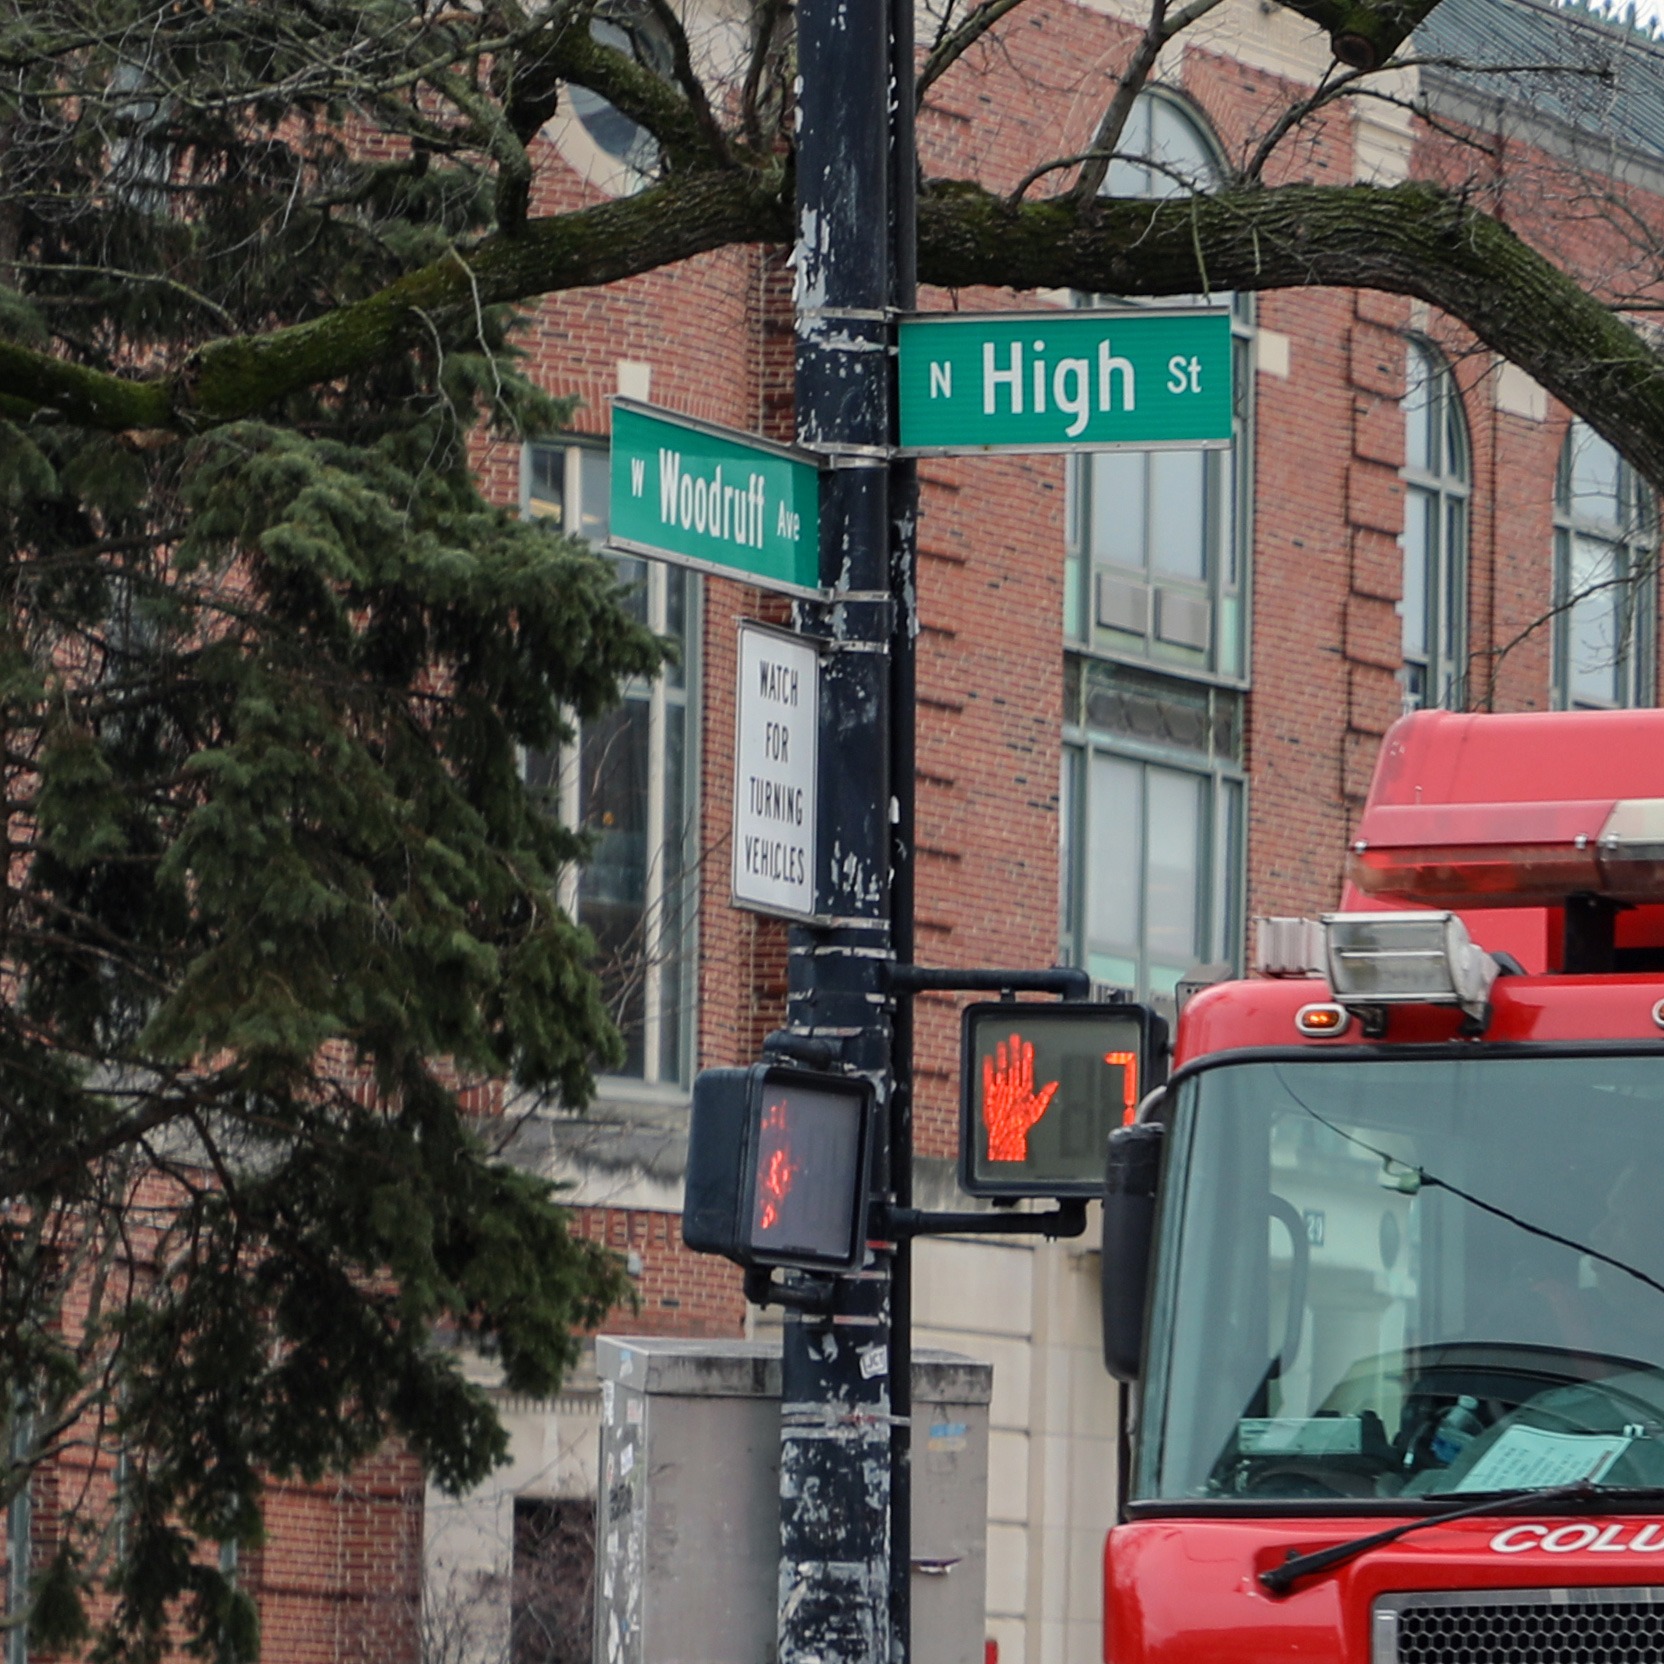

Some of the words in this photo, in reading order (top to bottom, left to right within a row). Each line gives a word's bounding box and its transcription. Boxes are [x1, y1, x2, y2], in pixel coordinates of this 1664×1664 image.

[930, 361, 952, 399] N
[983, 339, 1136, 438] High
[1167, 355, 1202, 394] St
[631, 457, 646, 498] W
[659, 447, 766, 549] Woodruff
[776, 499, 801, 542] Ave
[758, 659, 799, 708] WATCH
[765, 721, 790, 764] FOR
[750, 776, 803, 827] TURNING
[745, 834, 806, 887] VEHICLES
